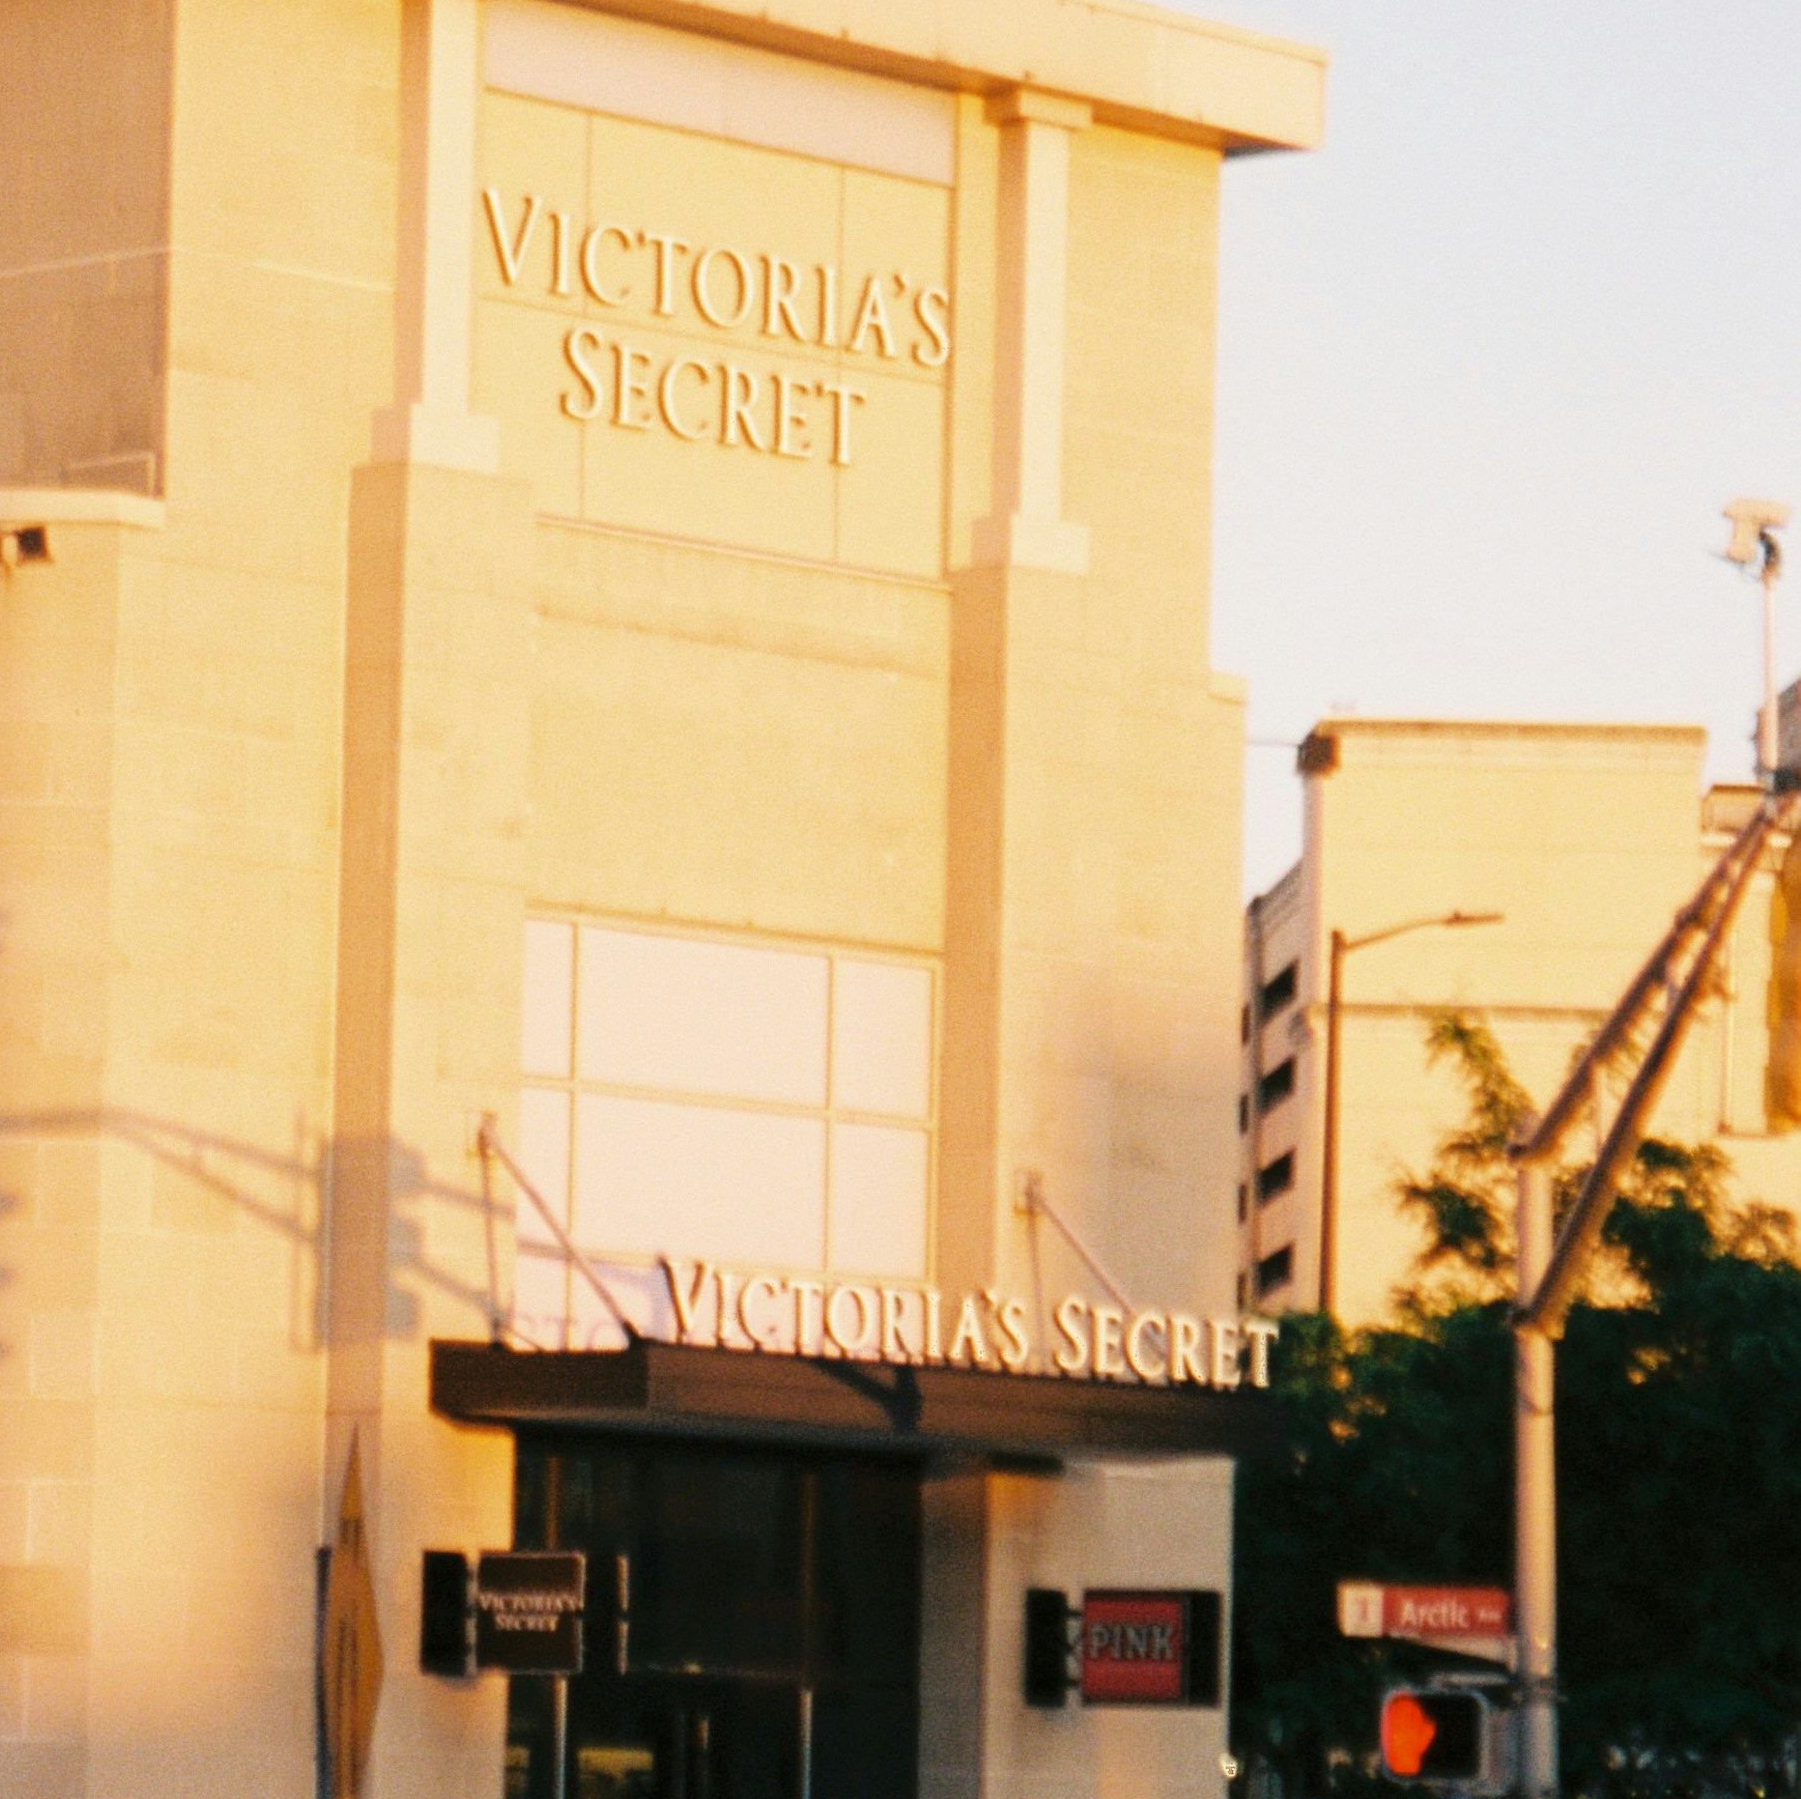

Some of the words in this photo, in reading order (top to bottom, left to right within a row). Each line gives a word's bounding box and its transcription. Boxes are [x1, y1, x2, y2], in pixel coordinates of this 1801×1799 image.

[482, 187, 951, 367] VICTORIA'S
[559, 327, 867, 467] SECRET
[657, 1257, 1029, 1374] VICTORIA'S
[1053, 1294, 1279, 1390] SECRET
[1089, 1623, 1174, 1660] PINK
